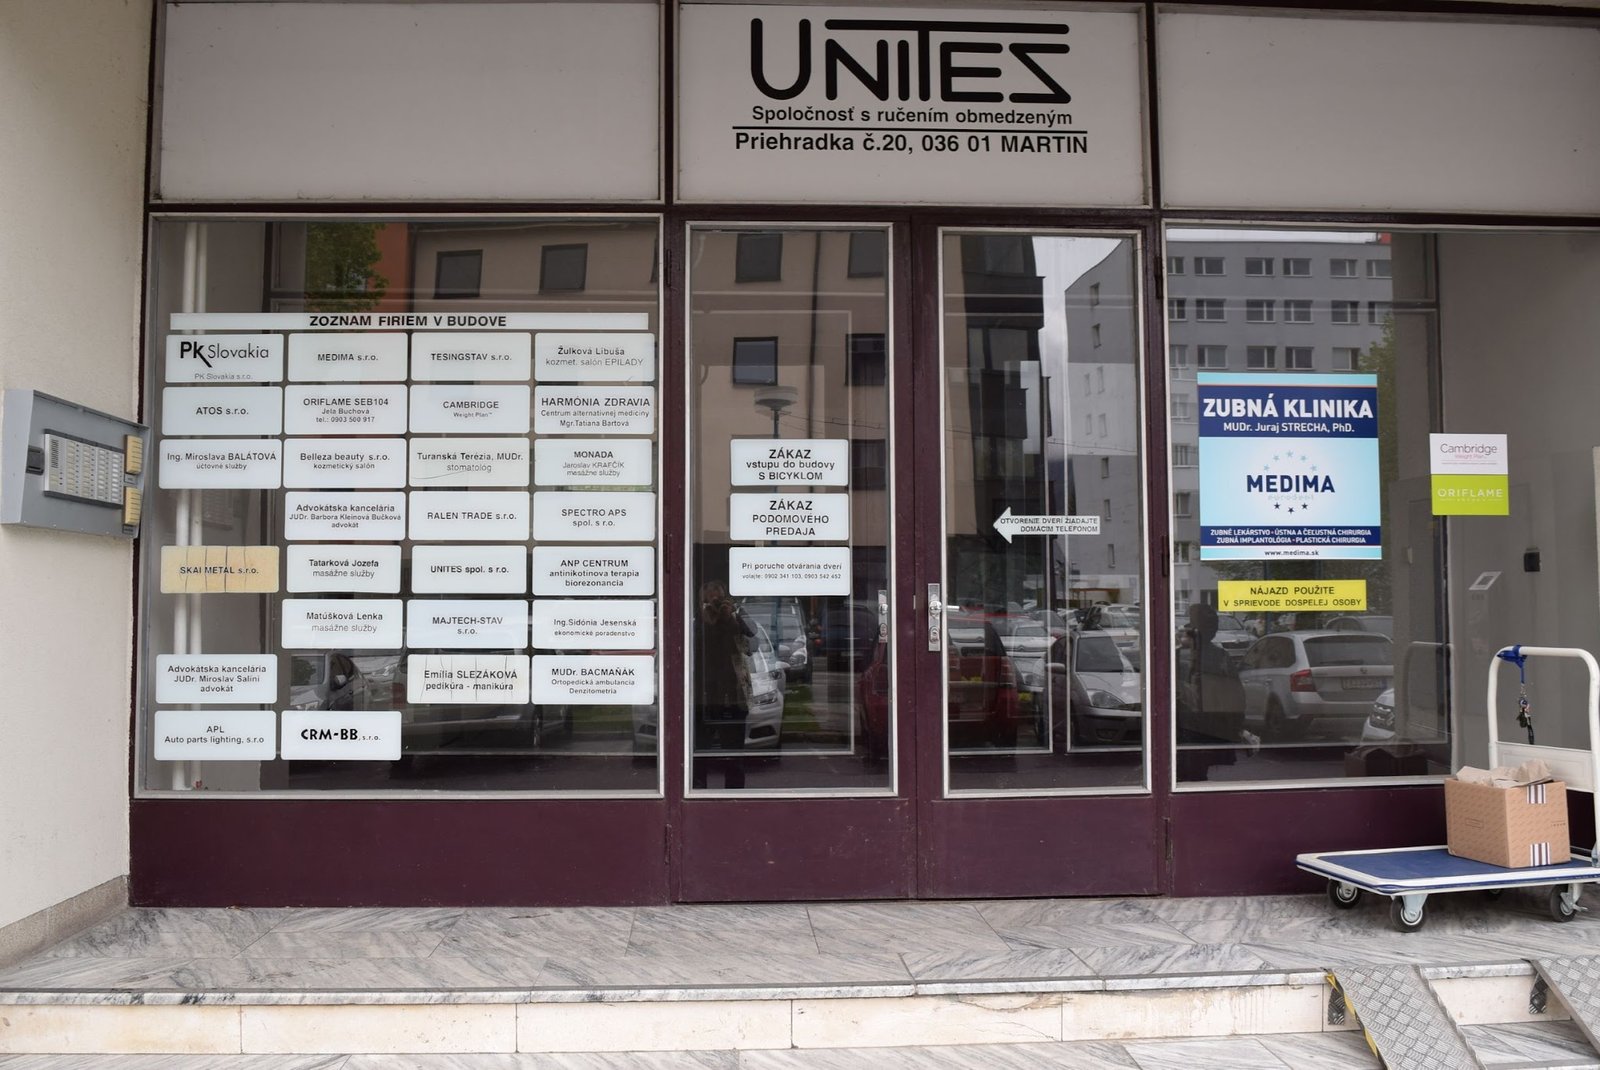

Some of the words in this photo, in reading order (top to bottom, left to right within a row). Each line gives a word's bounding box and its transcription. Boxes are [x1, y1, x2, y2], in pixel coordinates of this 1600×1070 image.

[750, 18, 1071, 104] UNITES
[751, 105, 854, 125] Spoločnosť
[860, 111, 870, 122] s
[877, 107, 948, 123] ručením
[955, 109, 1072, 127] obmedzeným
[735, 132, 854, 151] Priehradka
[863, 133, 913, 155] č.20,
[922, 135, 959, 153] 036
[967, 135, 991, 153] 01
[1001, 136, 1088, 154] MARTIN
[309, 315, 371, 326] ZOZNAM
[379, 315, 427, 326] FIRIEM
[433, 316, 443, 326] V
[447, 316, 506, 327] BUDOVE
[207, 343, 269, 359] Slovakia
[557, 345, 592, 355] Žulková
[431, 353, 488, 361] TESINGSTAV
[545, 358, 578, 366] kozmet.
[605, 358, 643, 366] EPILADY
[303, 398, 351, 406] ORIFLAME
[354, 398, 388, 406] SEB104
[443, 401, 499, 409] CAMBRIDGE
[604, 398, 650, 407] ZDRAVIA
[1203, 393, 1279, 417] ZUBNÁ
[1284, 399, 1373, 418] KLINIKA
[196, 407, 223, 415] ATOS
[1223, 422, 1253, 431] MUDr.
[1255, 422, 1279, 434] Juraj
[1281, 422, 1330, 433] STRECHA,
[1332, 423, 1355, 432] PhD.
[769, 447, 811, 459] ZÁKAZ
[1440, 443, 1498, 456] Cambridge
[167, 453, 183, 462] Ing.
[185, 453, 226, 461] Miroslava
[228, 451, 277, 461] BALÁTOVÁ
[300, 453, 332, 461] Belleza
[334, 453, 365, 462] beauty
[417, 452, 457, 460] Turanská
[497, 452, 523, 460] MUDr.
[746, 460, 779, 470] vstupu
[783, 460, 796, 468] do
[799, 460, 835, 471] budovy
[758, 472, 765, 480] S
[769, 472, 823, 480] BICYKLOM
[1247, 475, 1335, 493] MEDIMA
[1437, 489, 1502, 497] ORIFLAME
[769, 499, 813, 511] ZÁKAZ
[427, 512, 458, 520] RALEN
[461, 512, 492, 520] TRADE
[561, 509, 606, 517] SPECTRO
[608, 509, 627, 517] APS
[752, 513, 829, 524] PODOMOVÉHO
[572, 519, 593, 528] spol.
[766, 527, 816, 536] PREDAJA
[1337, 529, 1372, 537] CHIRURGIA
[1216, 536, 1239, 544] ZUBNÁ
[1240, 536, 1291, 544] IMPLANTOLÓGIA
[1296, 536, 1330, 544] PLASTICKÁ
[309, 559, 349, 567] Tatarková
[754, 563, 785, 571] poruche
[204, 567, 235, 575] METAL
[313, 569, 348, 577] masážne
[350, 569, 375, 579] služby
[465, 566, 485, 574] spol.
[1250, 586, 1289, 595] NÁJAZD
[1294, 586, 1334, 595] POUŽITE
[1233, 599, 1280, 607] SPRIEVODE
[1285, 599, 1328, 607] DOSPELEJ
[306, 612, 353, 620] Matúšková
[432, 617, 503, 625] MAJTECH-STAV
[311, 624, 349, 632] masážne
[351, 624, 377, 634] služby
[457, 670, 517, 679] SLEZÁKOVÁ
[551, 668, 578, 676] MUDr.
[581, 667, 635, 676] BACMAŇÁK
[164, 736, 184, 744] Auto
[186, 737, 208, 745] parts
[210, 736, 245, 745] lighting,
